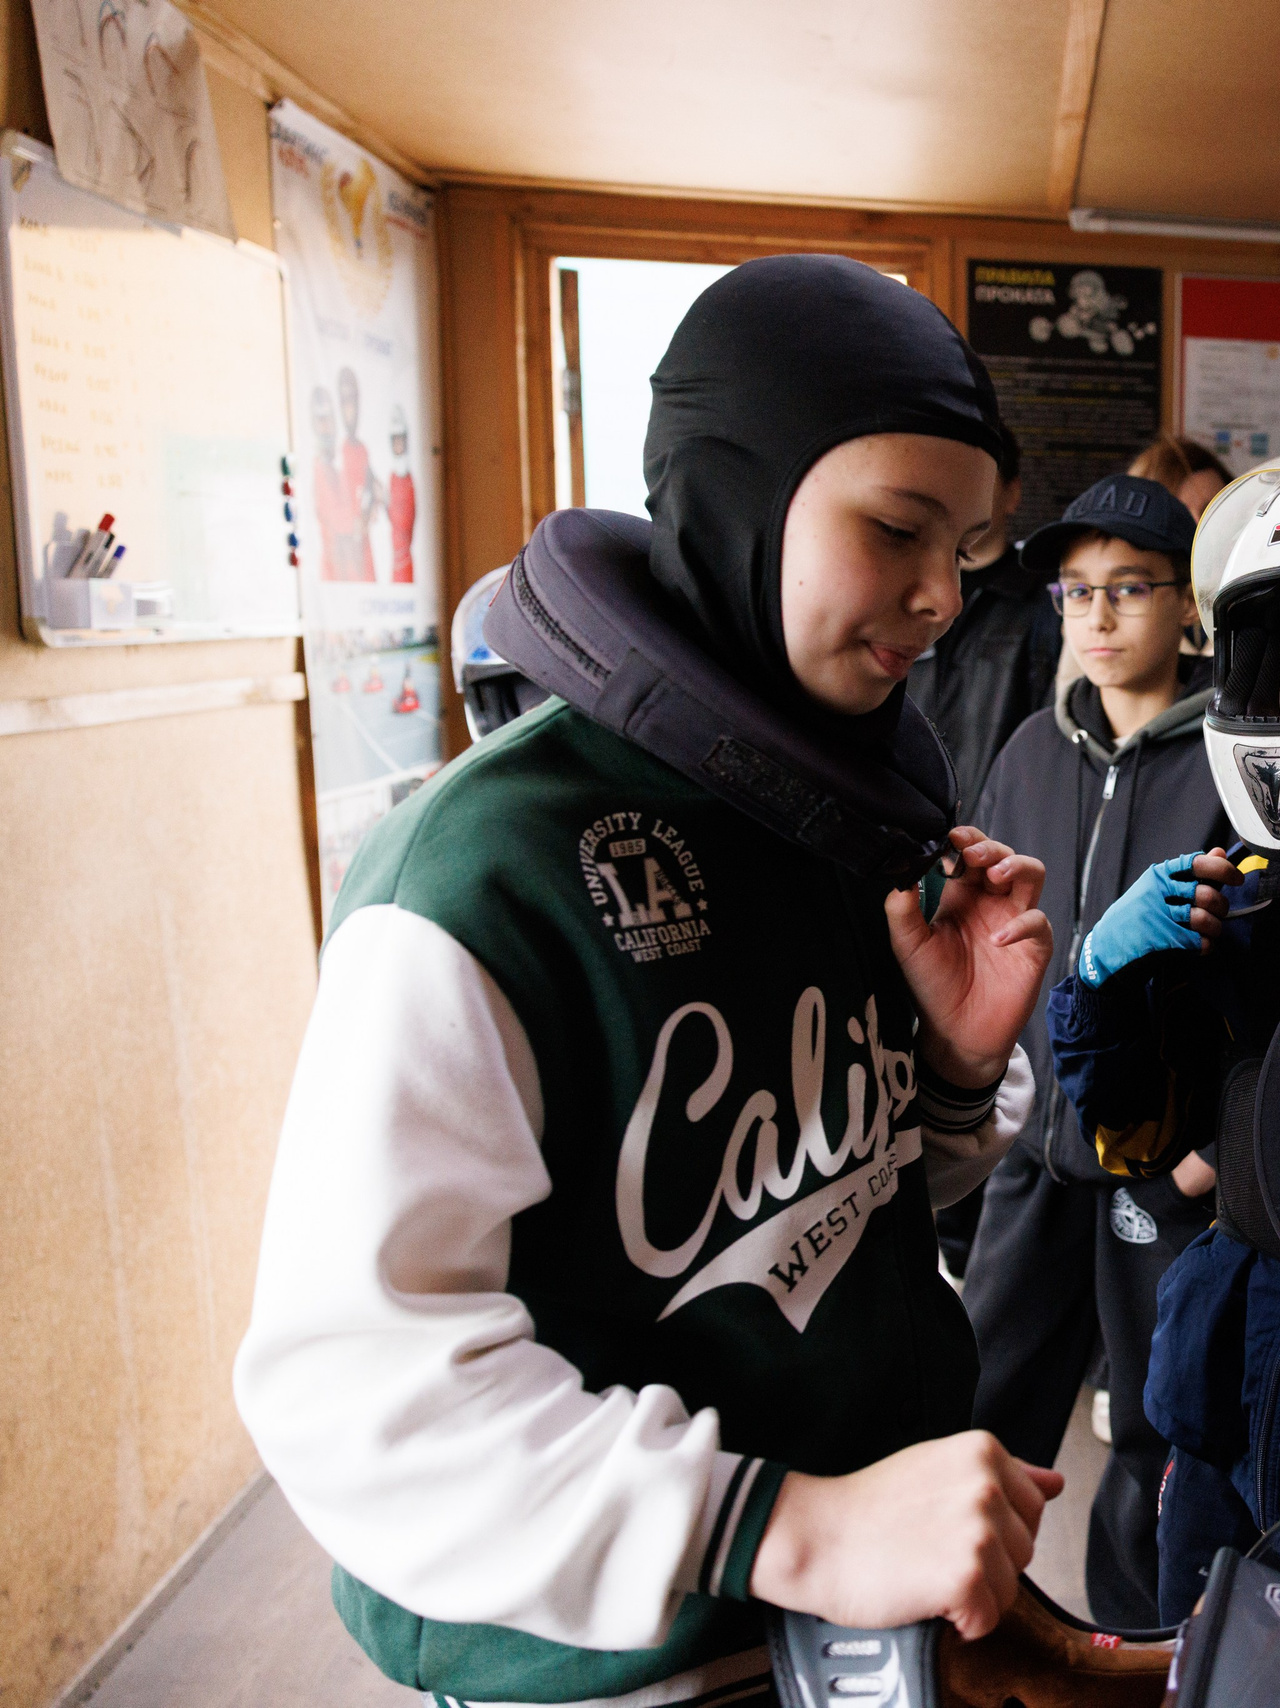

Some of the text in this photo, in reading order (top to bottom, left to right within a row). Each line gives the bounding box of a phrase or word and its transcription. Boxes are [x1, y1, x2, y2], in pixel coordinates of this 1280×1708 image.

[975, 266, 1055, 286] ПРАВИЛА
[975, 284, 1056, 305] ПРОКАТА
[579, 811, 642, 907] UNIVERSITY
[651, 818, 705, 892] LEAGUE
[611, 839, 645, 857] 1985
[614, 919, 711, 951] CALIFORNIA
[631, 939, 701, 963] WEST COAST
[768, 1192, 857, 1293] WEST
